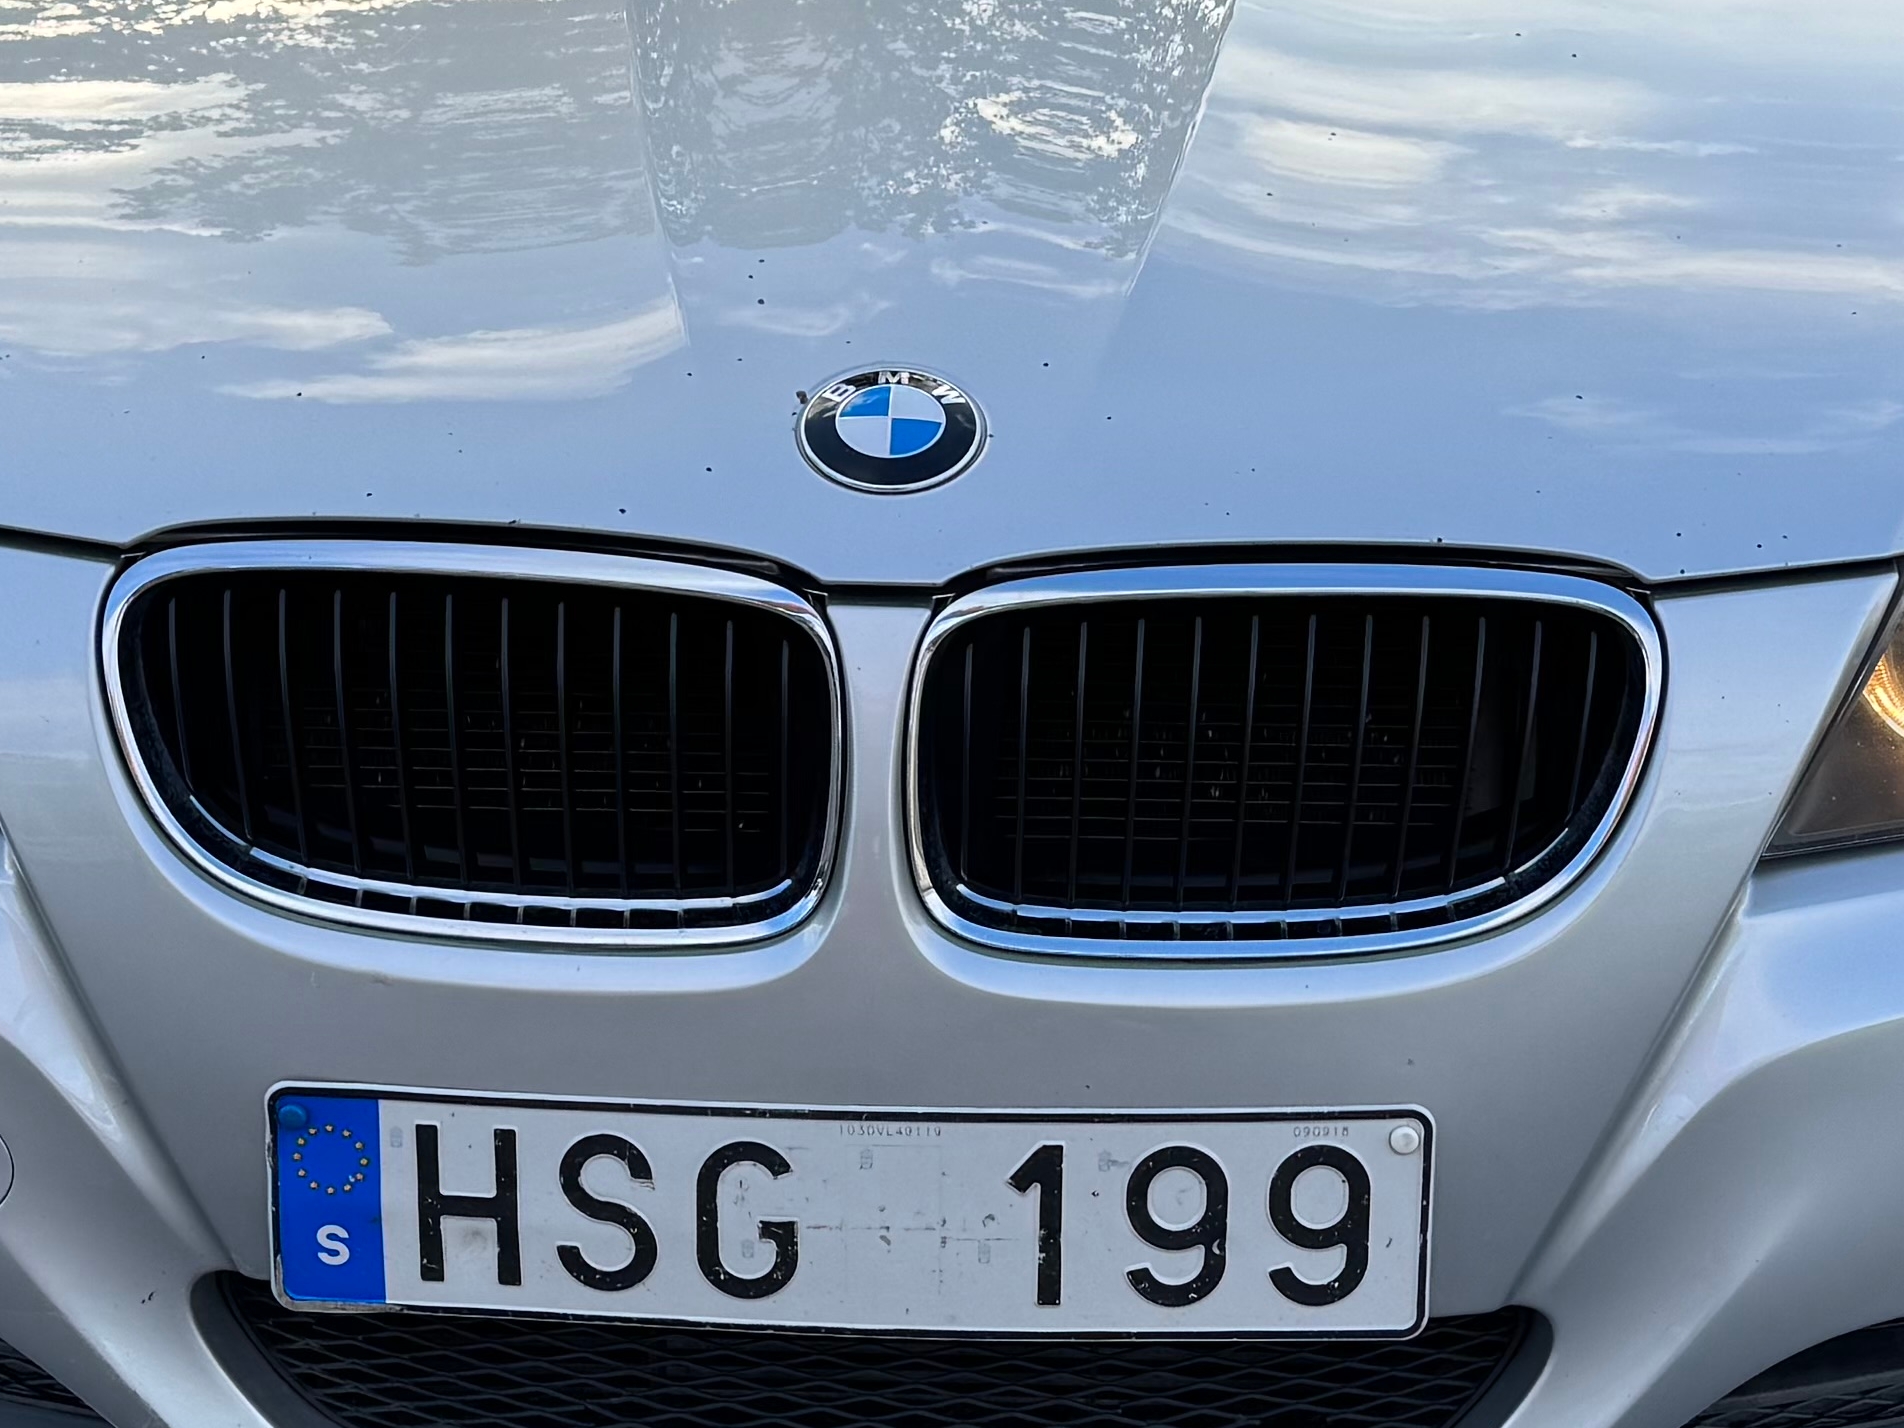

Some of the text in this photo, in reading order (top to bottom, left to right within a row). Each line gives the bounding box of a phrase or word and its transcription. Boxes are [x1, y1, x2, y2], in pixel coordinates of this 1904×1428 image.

[822, 371, 967, 404] BMW
[414, 1122, 1372, 1308] HSG 199
[315, 1224, 351, 1266] S
